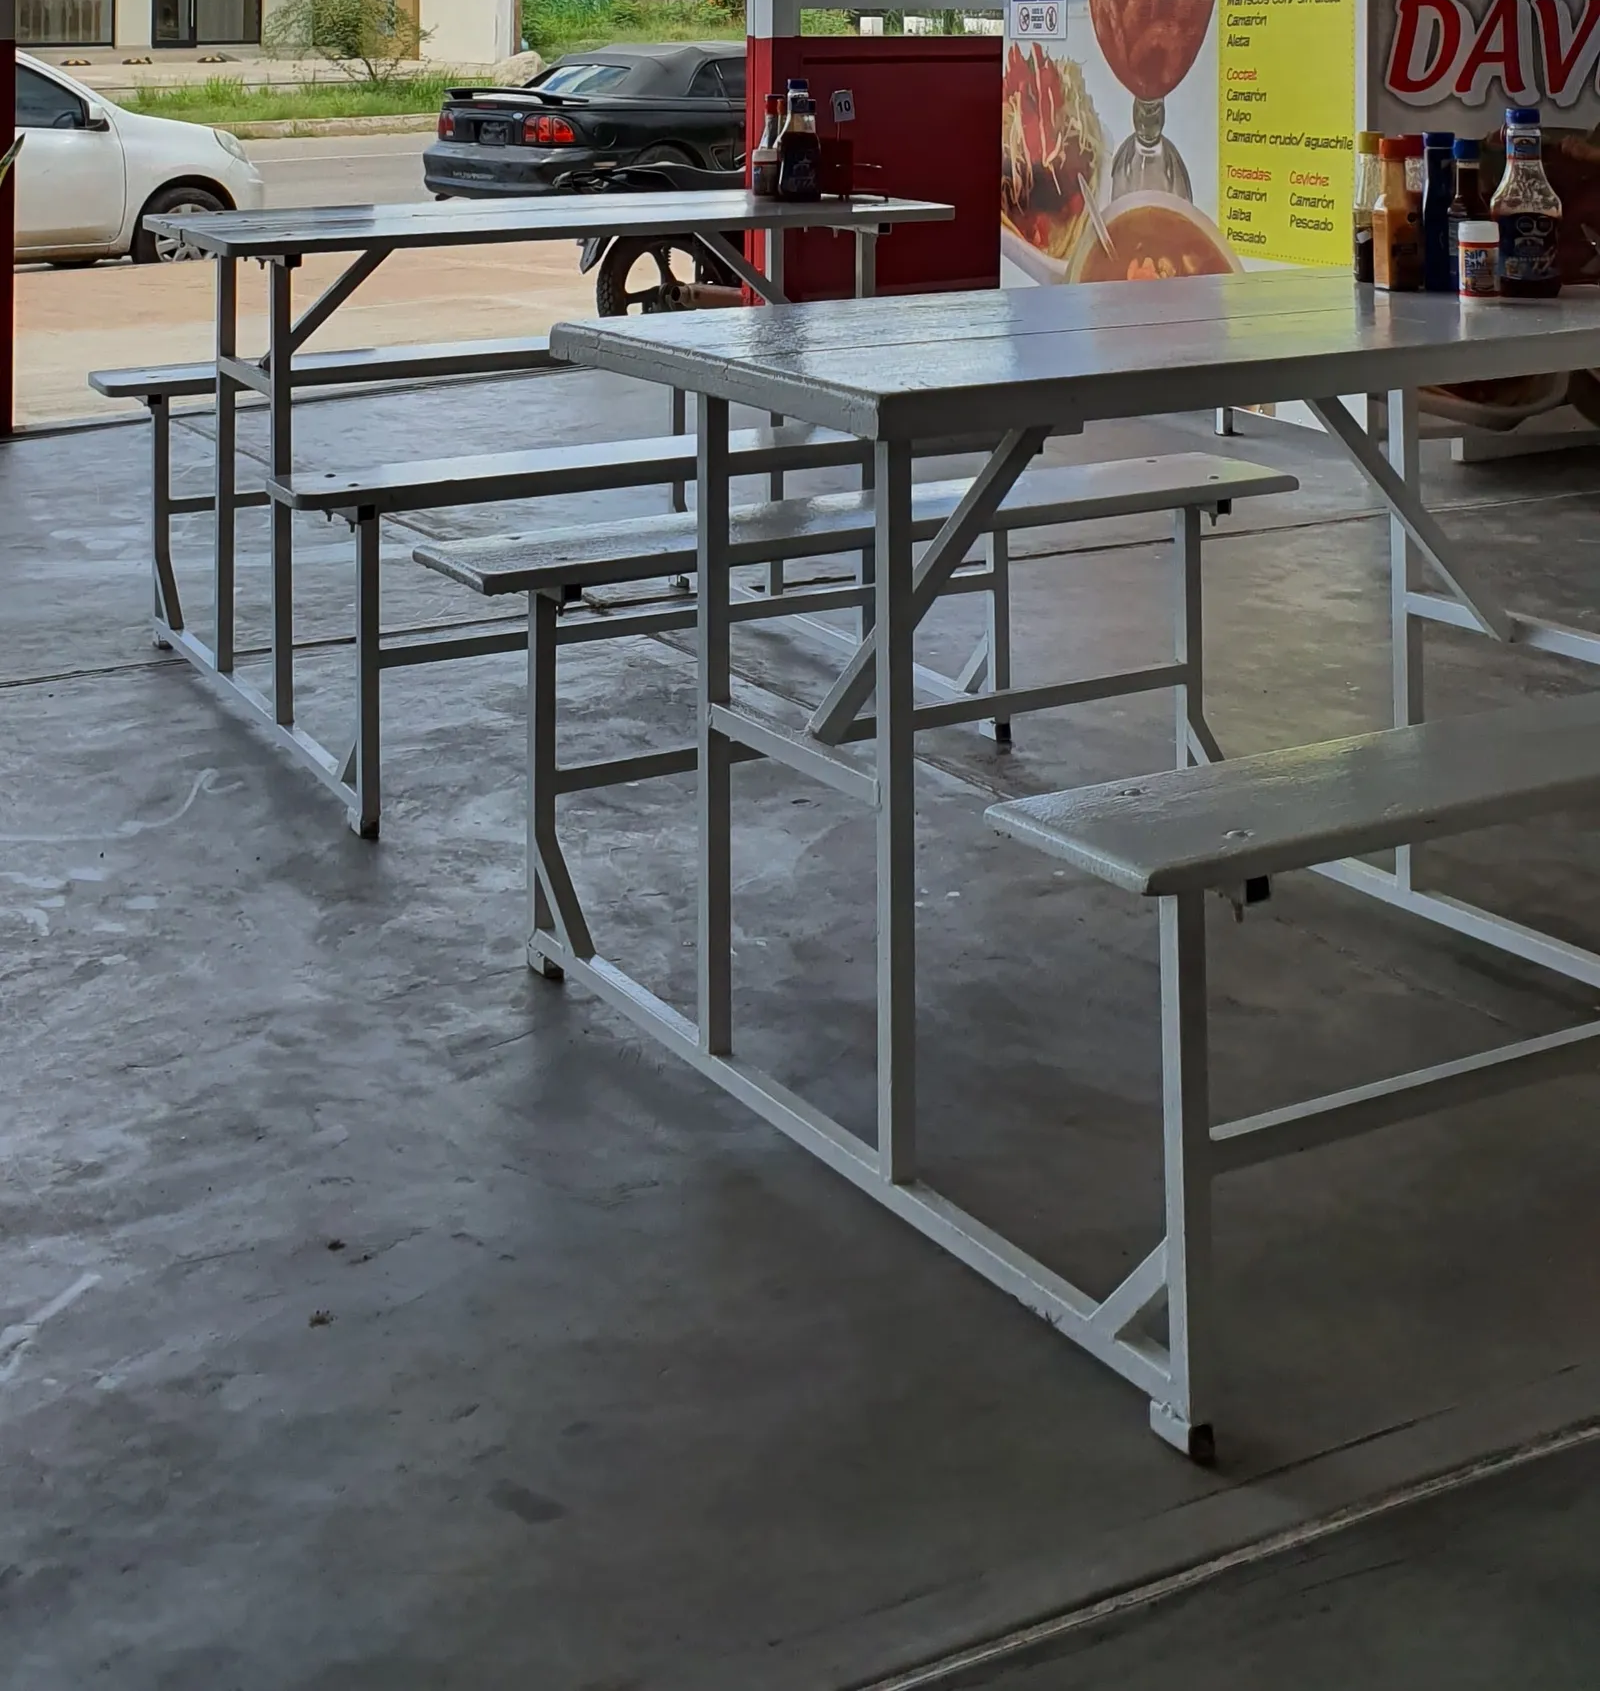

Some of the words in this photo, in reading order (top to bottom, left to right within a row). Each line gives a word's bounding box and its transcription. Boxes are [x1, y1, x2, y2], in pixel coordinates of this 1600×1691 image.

[1227, 12, 1267, 27] Camarón
[1227, 34, 1251, 47] Aleta
[1227, 88, 1267, 102] Camarón
[837, 100, 851, 112] 10
[1226, 109, 1251, 124] Pulpo
[1226, 130, 1266, 144] Camarón
[1227, 186, 1267, 202] Camarón
[1290, 193, 1334, 210] Camarón
[1227, 207, 1251, 222] Jaiba
[1290, 214, 1334, 232] Pescado
[1227, 227, 1267, 244] Pescado
